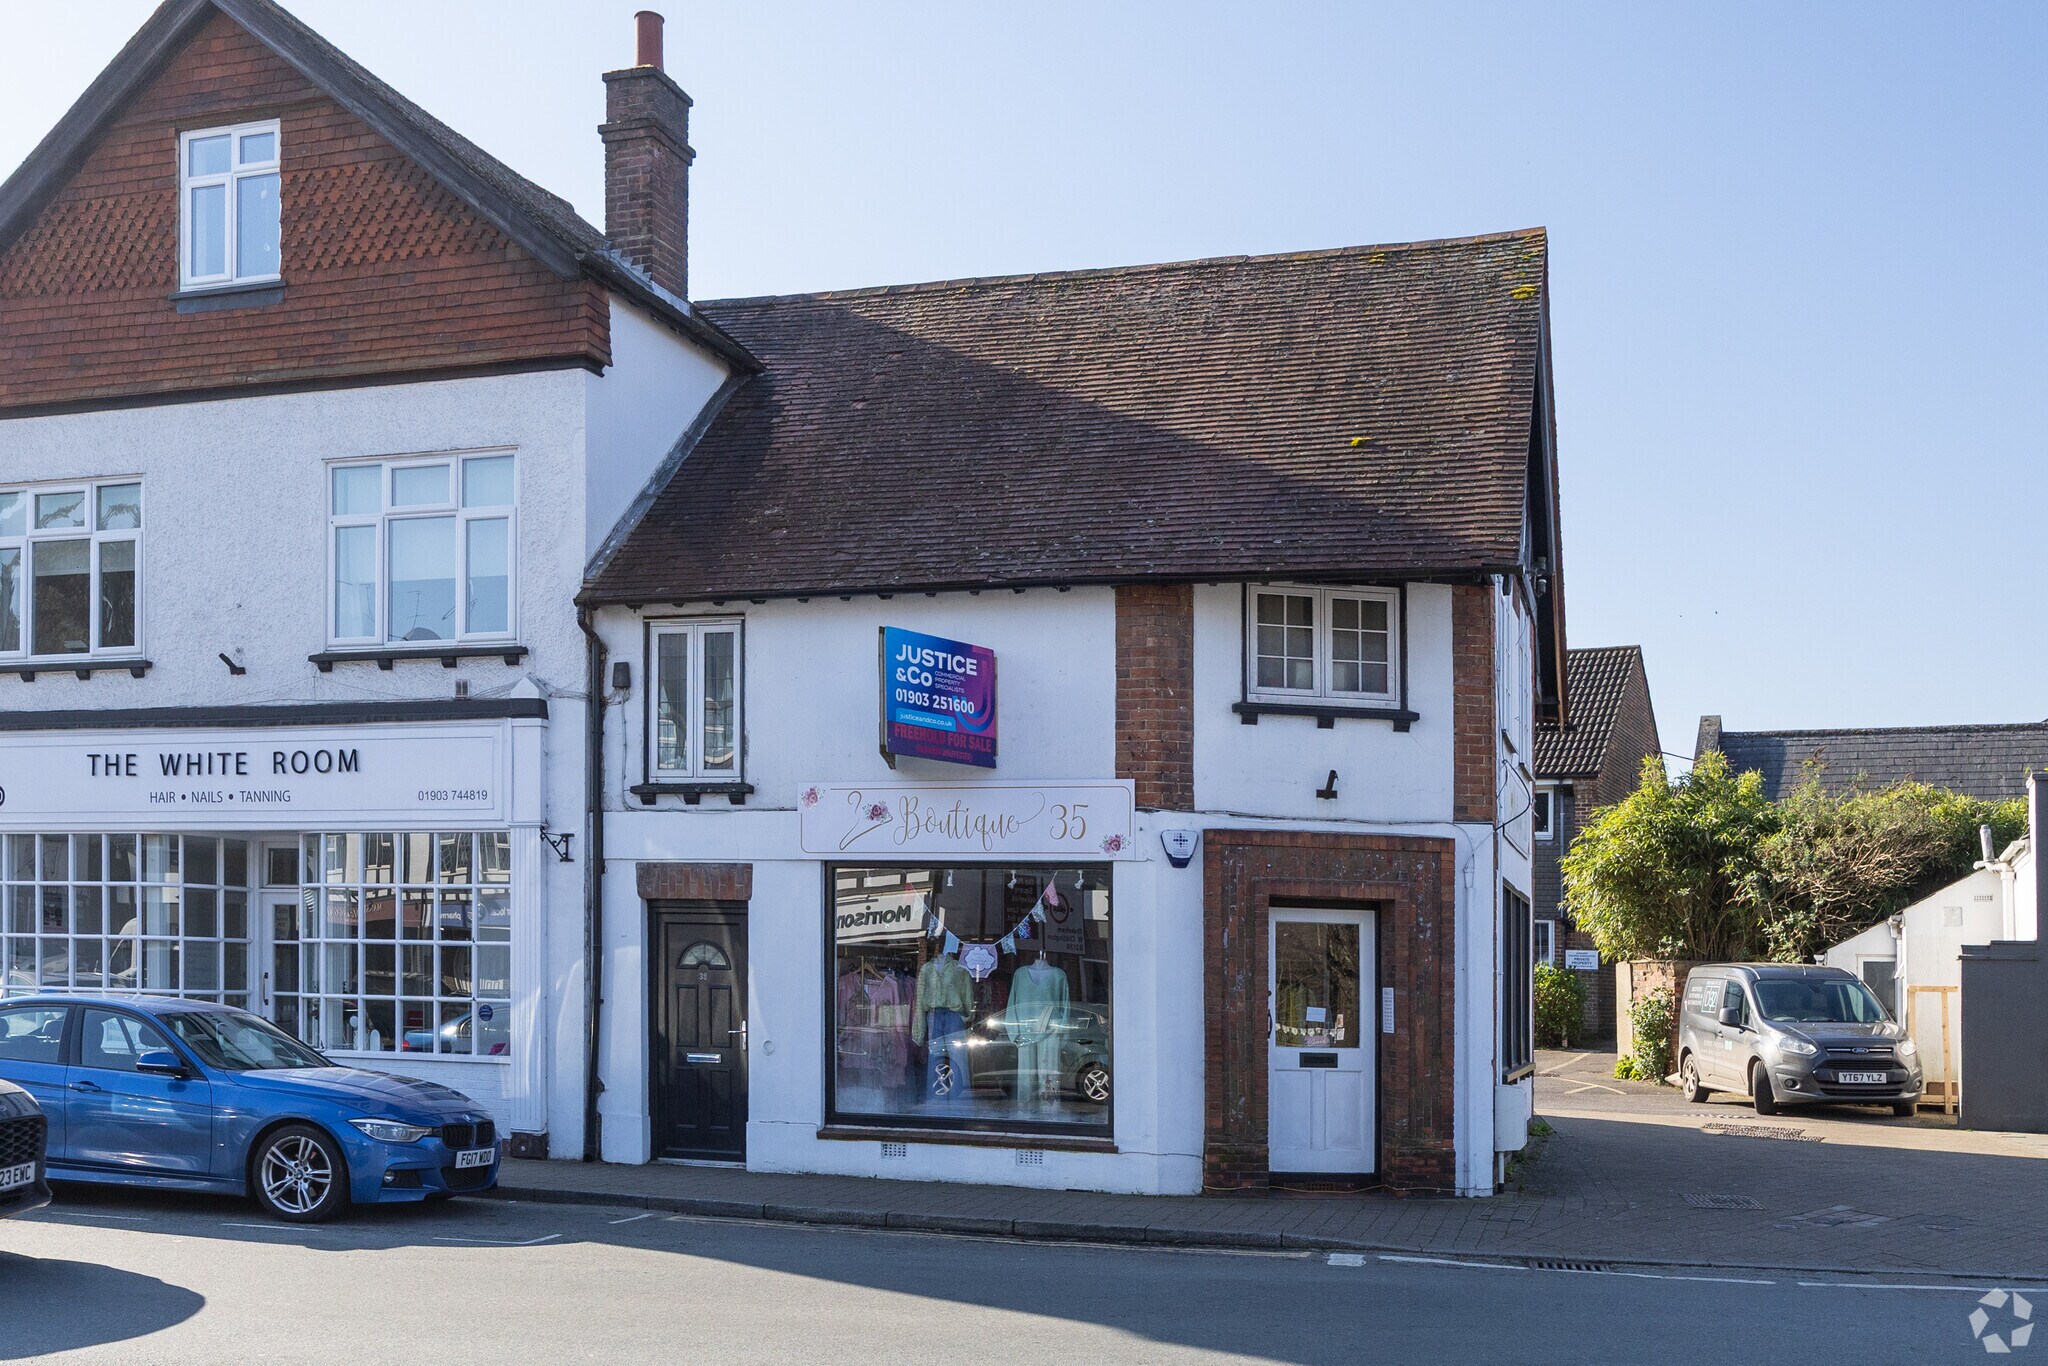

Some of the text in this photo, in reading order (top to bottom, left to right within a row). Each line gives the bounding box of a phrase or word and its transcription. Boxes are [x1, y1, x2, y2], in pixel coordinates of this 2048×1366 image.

[896, 644, 978, 676] JUSTICE
[934, 671, 966, 682] COMMERCIAL
[934, 677, 961, 687] PROPERTY
[934, 683, 966, 694] SPECIALISTS
[896, 688, 975, 715] 01903 251600
[900, 713, 953, 727] justiceandco.co.uk
[894, 724, 992, 753] FREEHOLD FOR SALE
[87, 748, 360, 777] THE WHITE ROOM
[149, 789, 292, 804] HAIR NAILS TANNING
[417, 788, 488, 801] 01903 744819
[893, 791, 1089, 852] Boutique 35
[1842, 1073, 1883, 1082] YT67 YLZ
[461, 1152, 478, 1166] FG17
